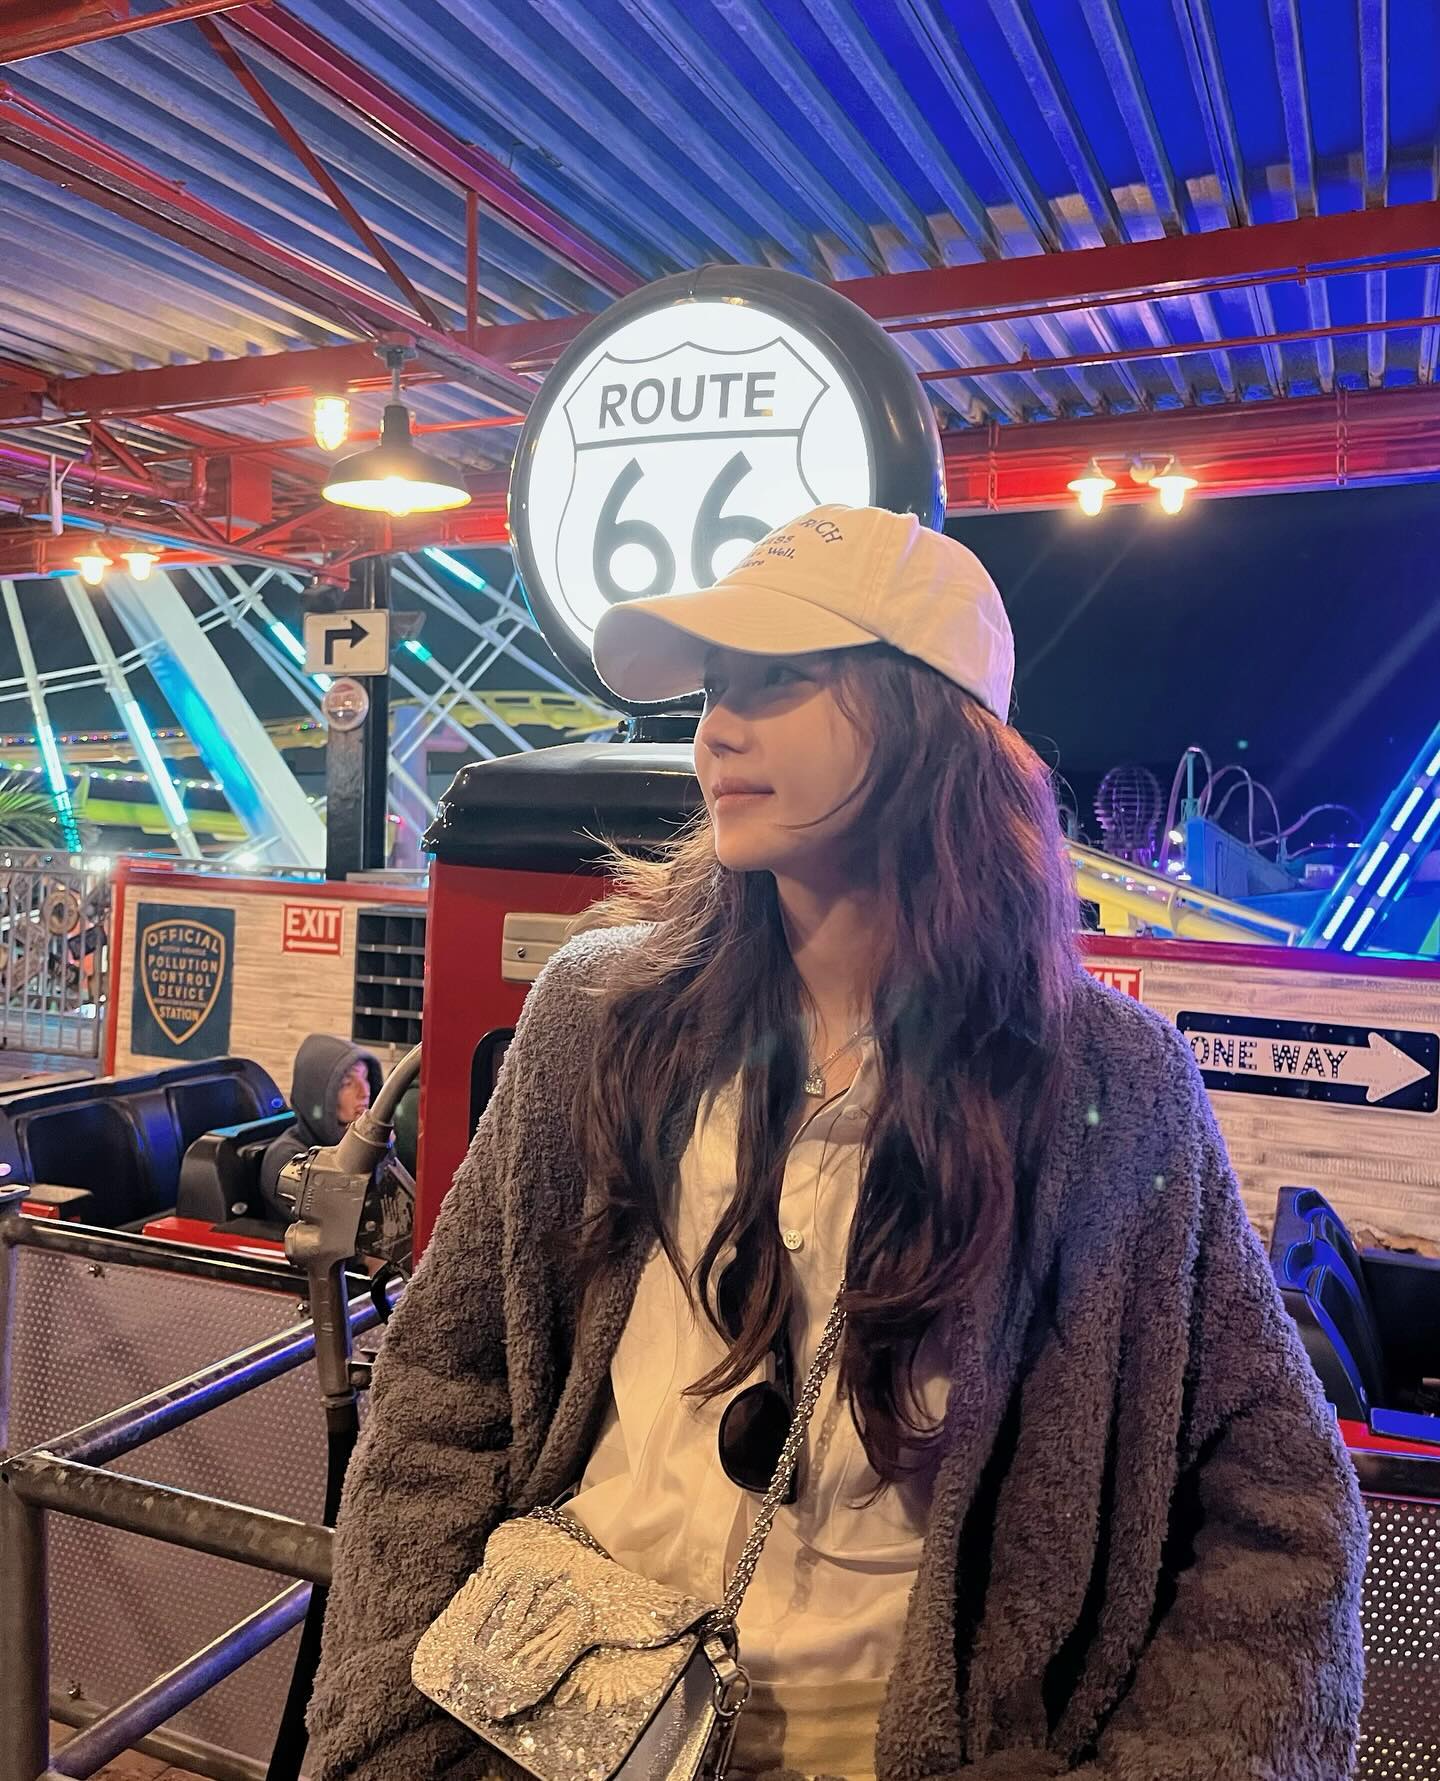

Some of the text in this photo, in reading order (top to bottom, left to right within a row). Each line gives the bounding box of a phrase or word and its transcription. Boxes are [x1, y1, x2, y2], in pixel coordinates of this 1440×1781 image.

[599, 371, 776, 429] ROUTE
[592, 450, 773, 605] 66
[287, 908, 340, 939] EXIT
[147, 928, 219, 954] OFFICIAL
[148, 955, 218, 973] POLLUTION
[152, 969, 211, 987] CONTROL
[1088, 971, 1137, 997] IT
[158, 983, 205, 1001] DEVICE
[159, 1006, 201, 1021] STATION
[1190, 1036, 1347, 1078] ONE WAY
